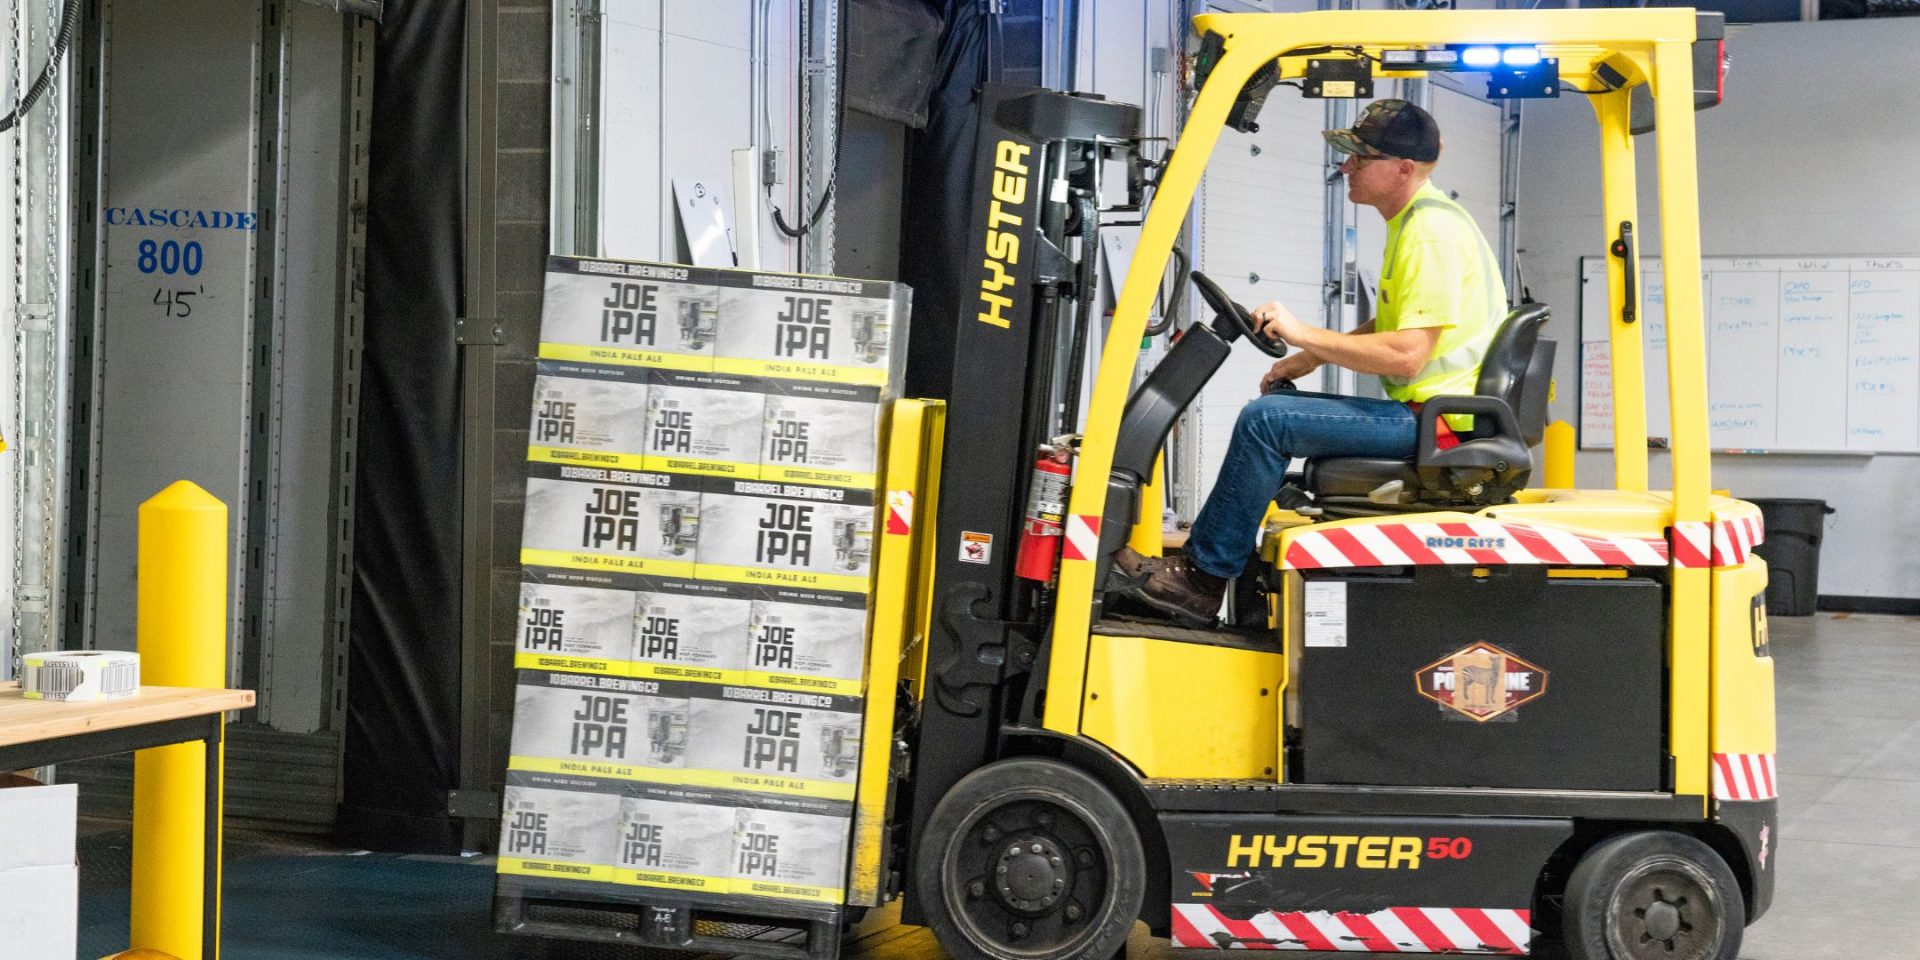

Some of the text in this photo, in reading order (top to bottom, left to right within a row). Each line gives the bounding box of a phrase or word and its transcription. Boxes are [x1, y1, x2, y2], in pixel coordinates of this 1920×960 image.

[106, 207, 257, 230] CASCADE
[978, 140, 1030, 329] HYSTER
[137, 239, 203, 276] 800
[604, 283, 658, 311] JOE
[778, 297, 832, 325] JOE
[602, 310, 656, 345] IPA
[775, 324, 830, 359] IPA
[590, 350, 662, 362] INDIA PALE ALE
[764, 364, 836, 376] INDIA PALE ALE
[539, 400, 576, 420] JOE
[656, 410, 693, 429] JOE
[537, 419, 575, 443] IPA
[654, 429, 691, 453] IPA
[773, 420, 809, 439] JOE
[770, 439, 808, 463] IPA
[586, 488, 640, 517] JOE
[760, 503, 814, 532] JOE
[583, 515, 638, 551] IPA
[1426, 537, 1504, 548] RIDE RITE
[756, 530, 811, 566] IPA
[572, 556, 644, 568] INDIA PALE ALE
[745, 570, 817, 583] INDIA PALE ALE
[527, 608, 564, 627] JOE
[642, 617, 679, 636] JOE
[525, 627, 562, 651] IPA
[640, 635, 678, 659] IPA
[758, 625, 795, 645] JOE
[755, 644, 793, 669] IPA
[574, 695, 629, 724] JOE
[747, 708, 802, 738] JOE
[571, 722, 627, 758] IPA
[744, 736, 799, 772] IPA
[560, 762, 632, 776] INDIA PALE ALE
[732, 776, 805, 790] INDIA PALE ALE
[511, 811, 548, 831] JOE
[626, 823, 663, 843] JOE
[509, 830, 546, 854] IPA
[623, 841, 661, 867] IPA
[741, 832, 779, 852] JOE
[1226, 835, 1472, 869] HYSTER 50
[739, 852, 776, 876] IPA
